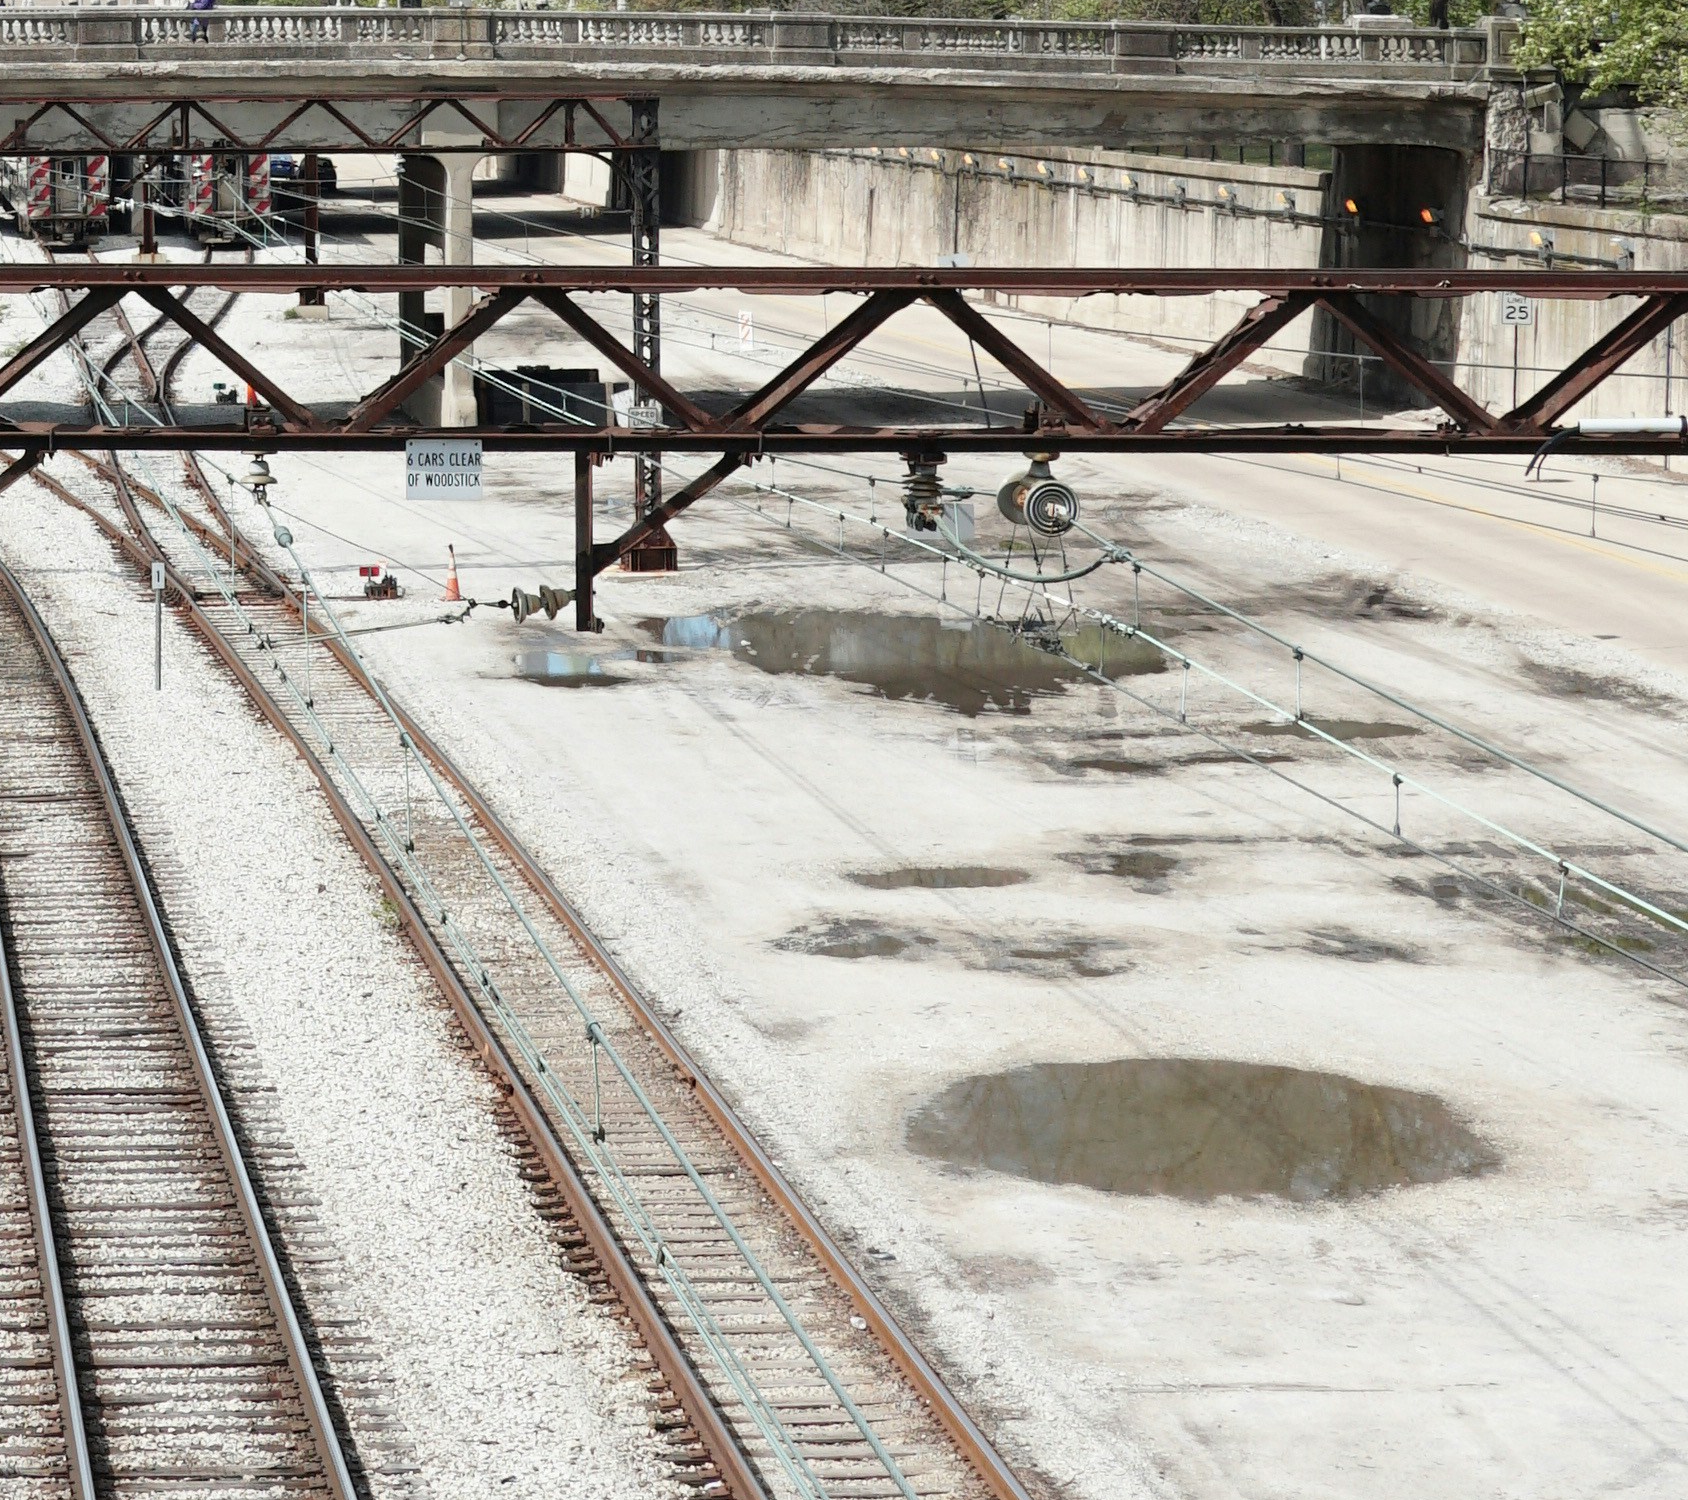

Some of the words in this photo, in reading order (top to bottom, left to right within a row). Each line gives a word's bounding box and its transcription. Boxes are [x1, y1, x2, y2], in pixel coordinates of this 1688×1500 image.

[1505, 305, 1529, 320] 25
[407, 453, 413, 466] 6
[418, 453, 445, 467] CARS
[449, 453, 481, 467] CLEAR
[408, 473, 420, 487] OF
[425, 473, 480, 487] WOODSTICK
